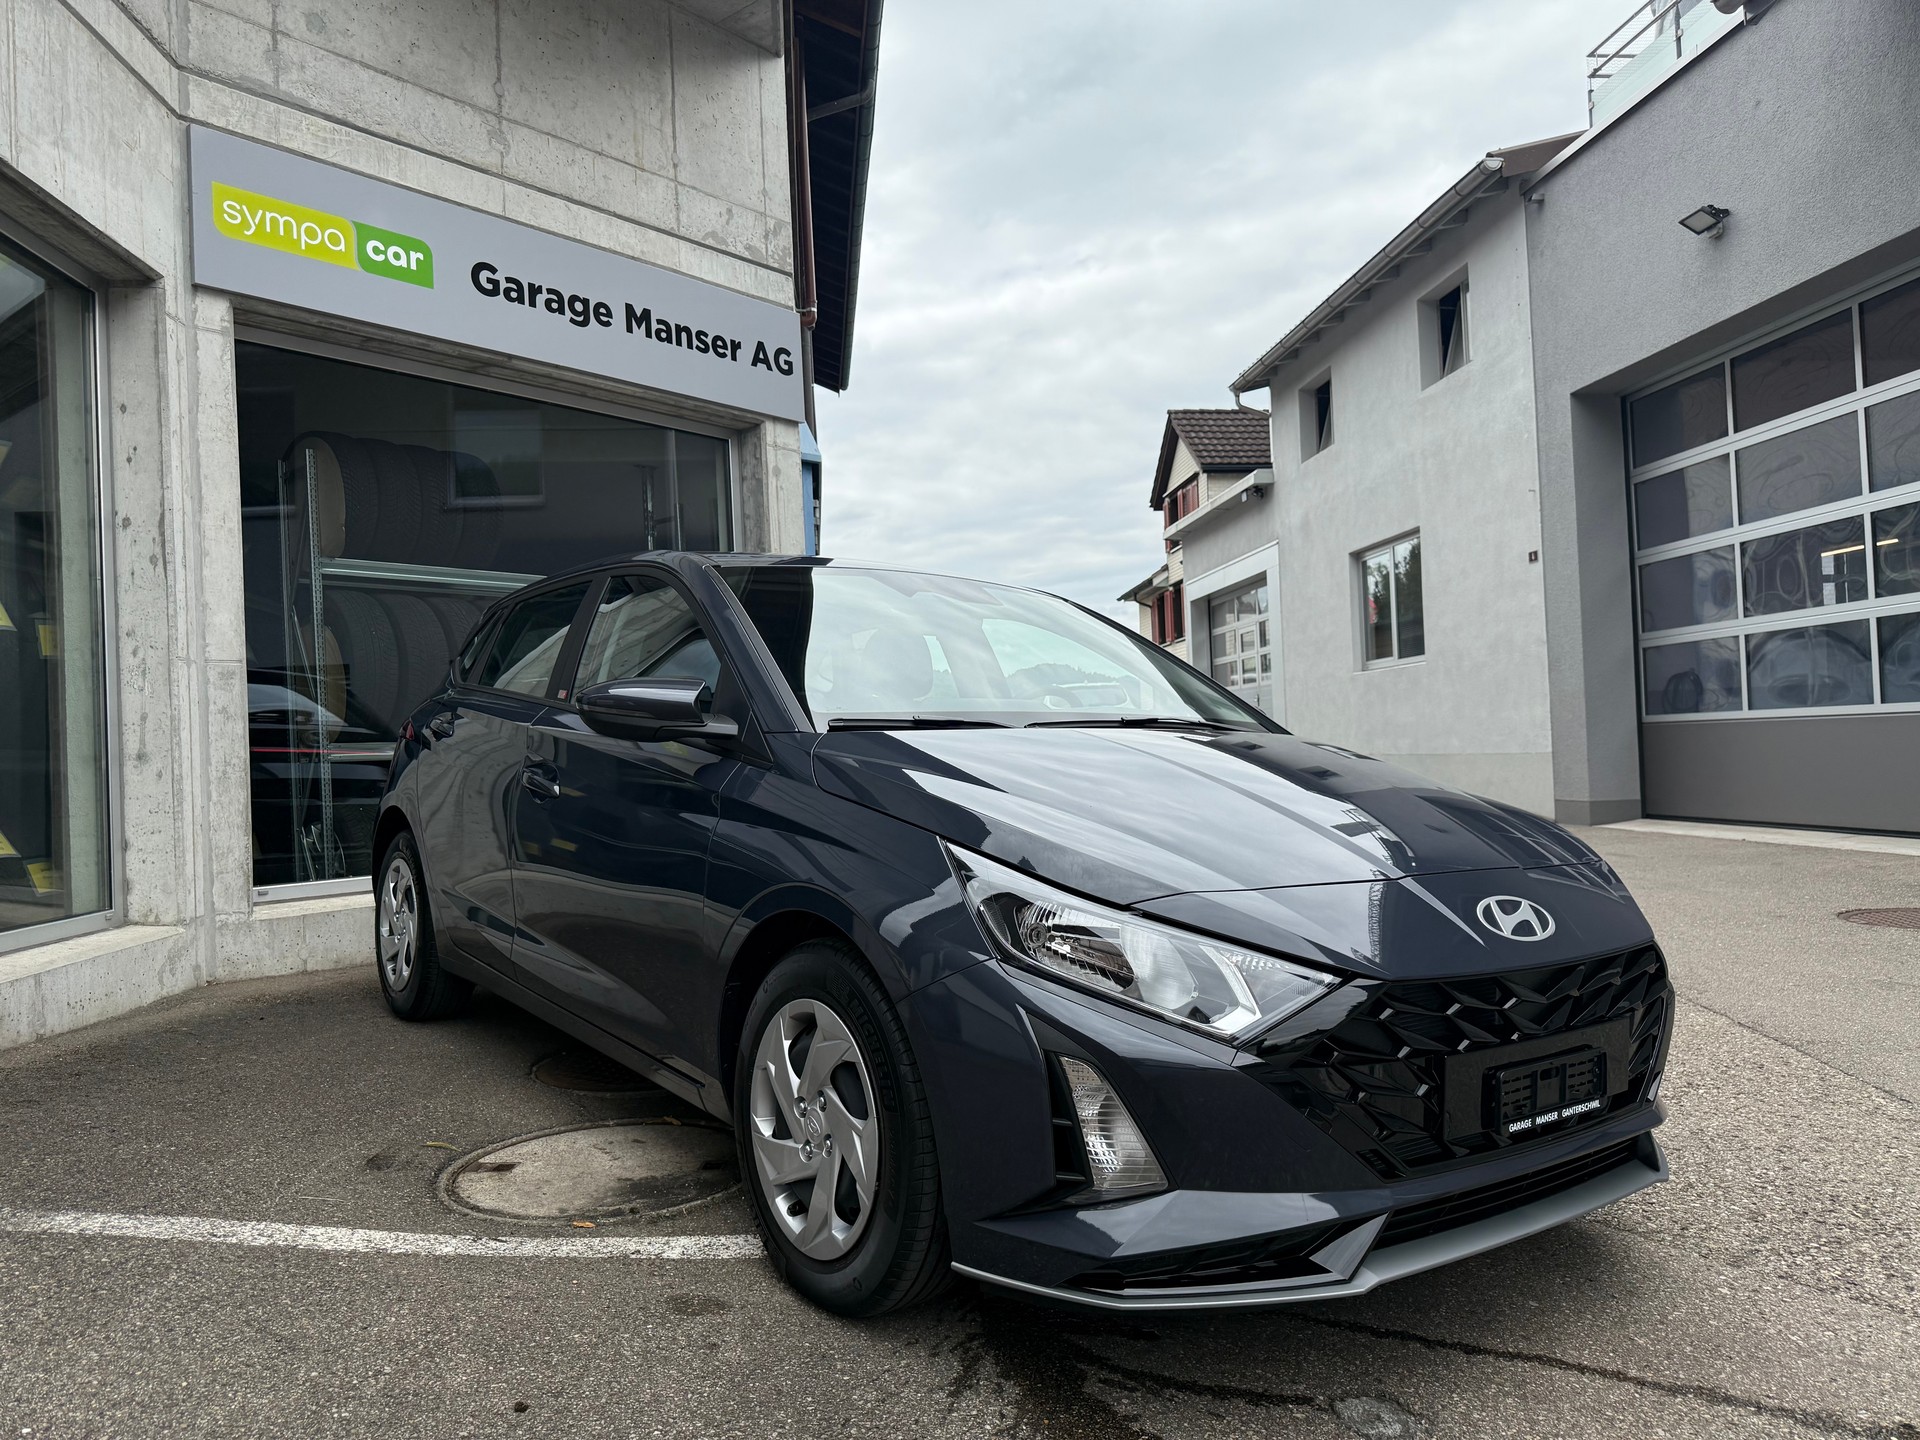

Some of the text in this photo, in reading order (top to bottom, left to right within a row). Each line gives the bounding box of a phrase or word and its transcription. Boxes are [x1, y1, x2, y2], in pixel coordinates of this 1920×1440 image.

[222, 200, 424, 272] sympa car
[470, 261, 794, 377] Garage Manser AG
[1508, 1099, 1600, 1132] GARAGE MANSER GANTERSCHWIL
